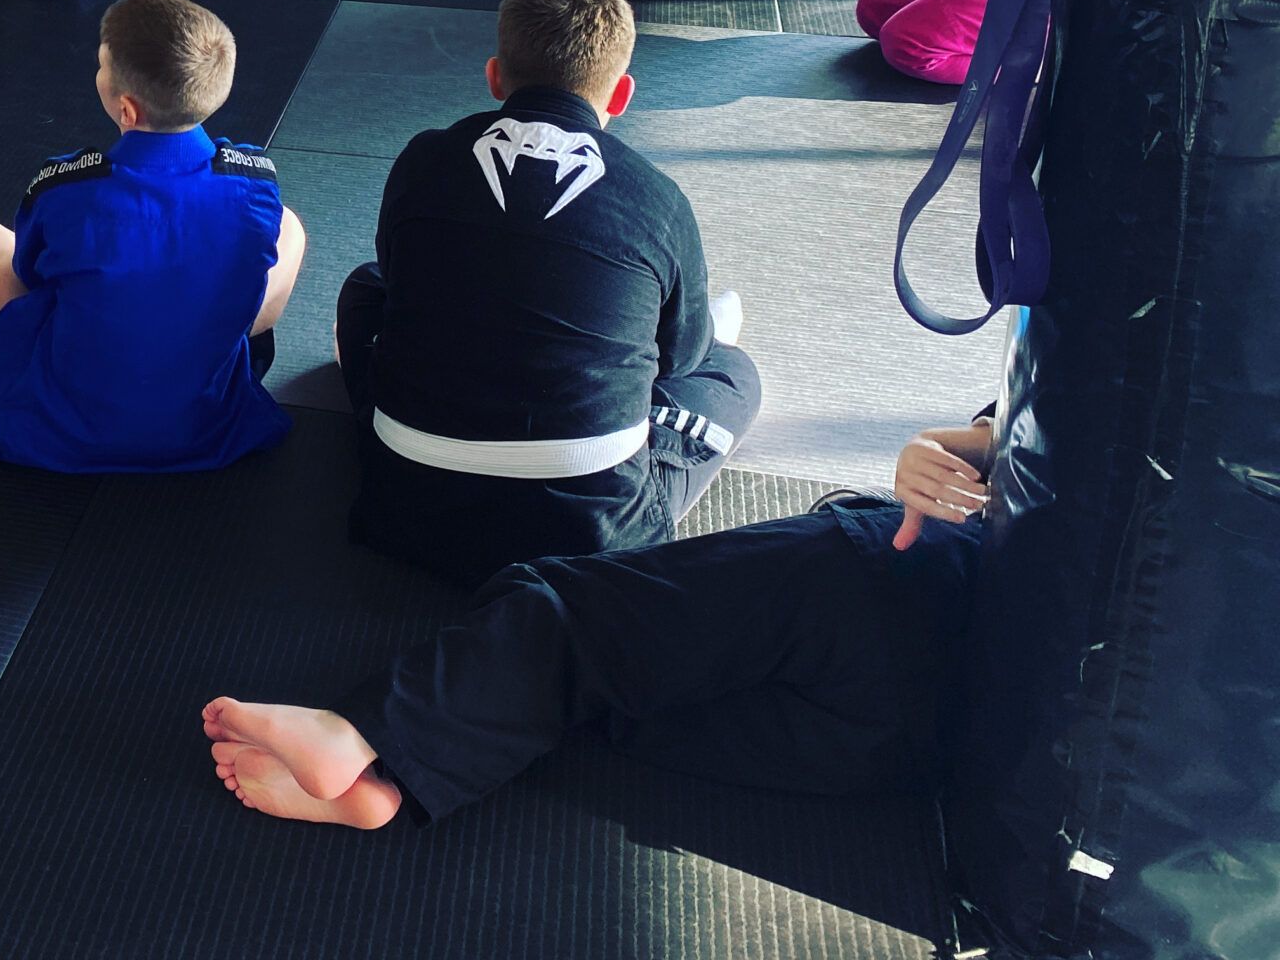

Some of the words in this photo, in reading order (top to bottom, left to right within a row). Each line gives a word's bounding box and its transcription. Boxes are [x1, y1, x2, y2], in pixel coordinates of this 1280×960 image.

[57, 152, 103, 175] GROUND
[220, 147, 253, 168] FORCE
[30, 163, 59, 187] FOR
